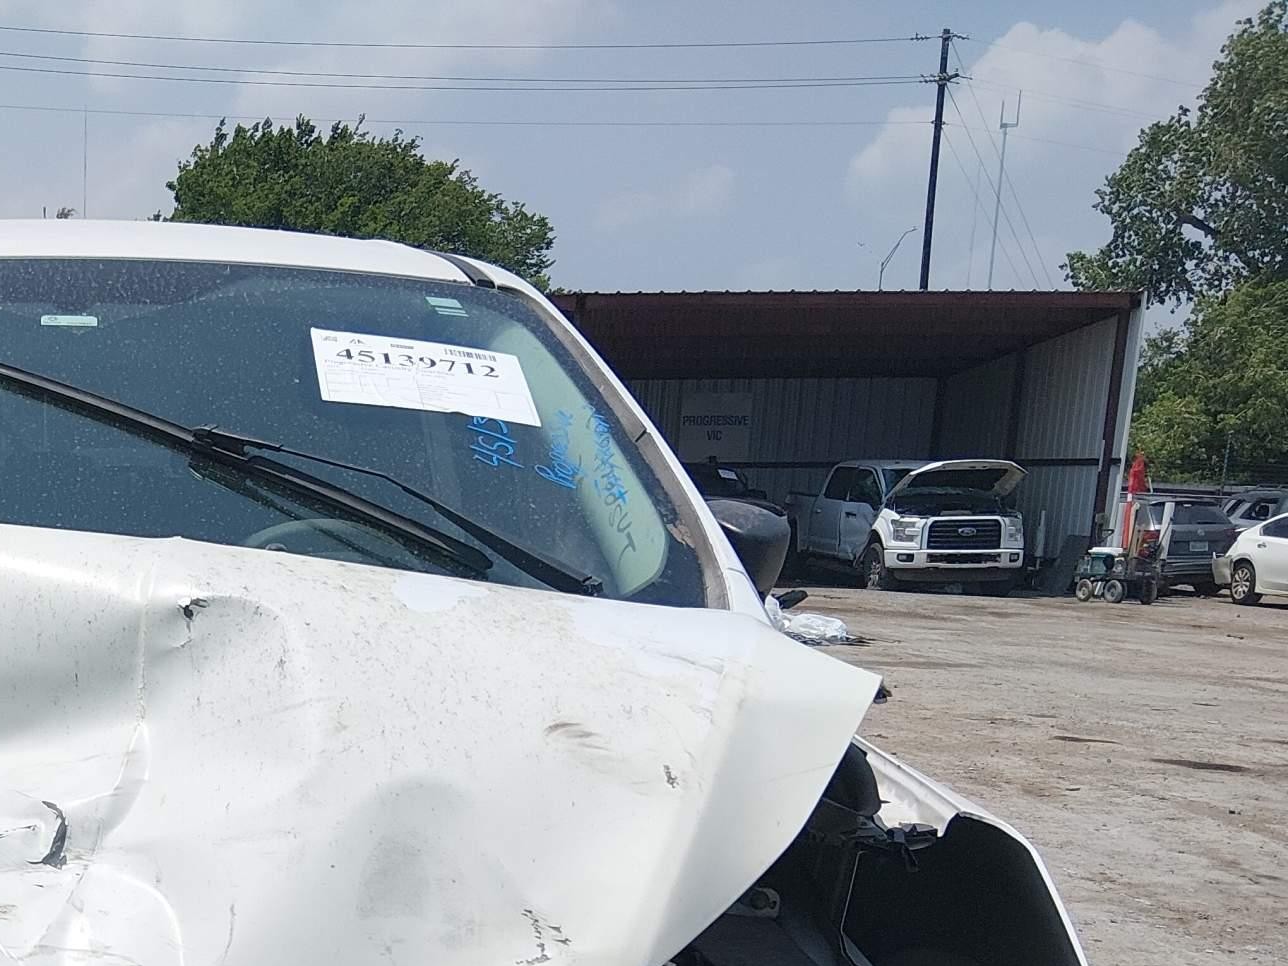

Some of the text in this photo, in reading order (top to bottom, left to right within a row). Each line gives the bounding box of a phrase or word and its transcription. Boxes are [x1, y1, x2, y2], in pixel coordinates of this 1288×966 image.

[335, 347, 500, 379] 45139712
[682, 415, 749, 426] PROGRESSIVE
[706, 430, 722, 441] VIC
